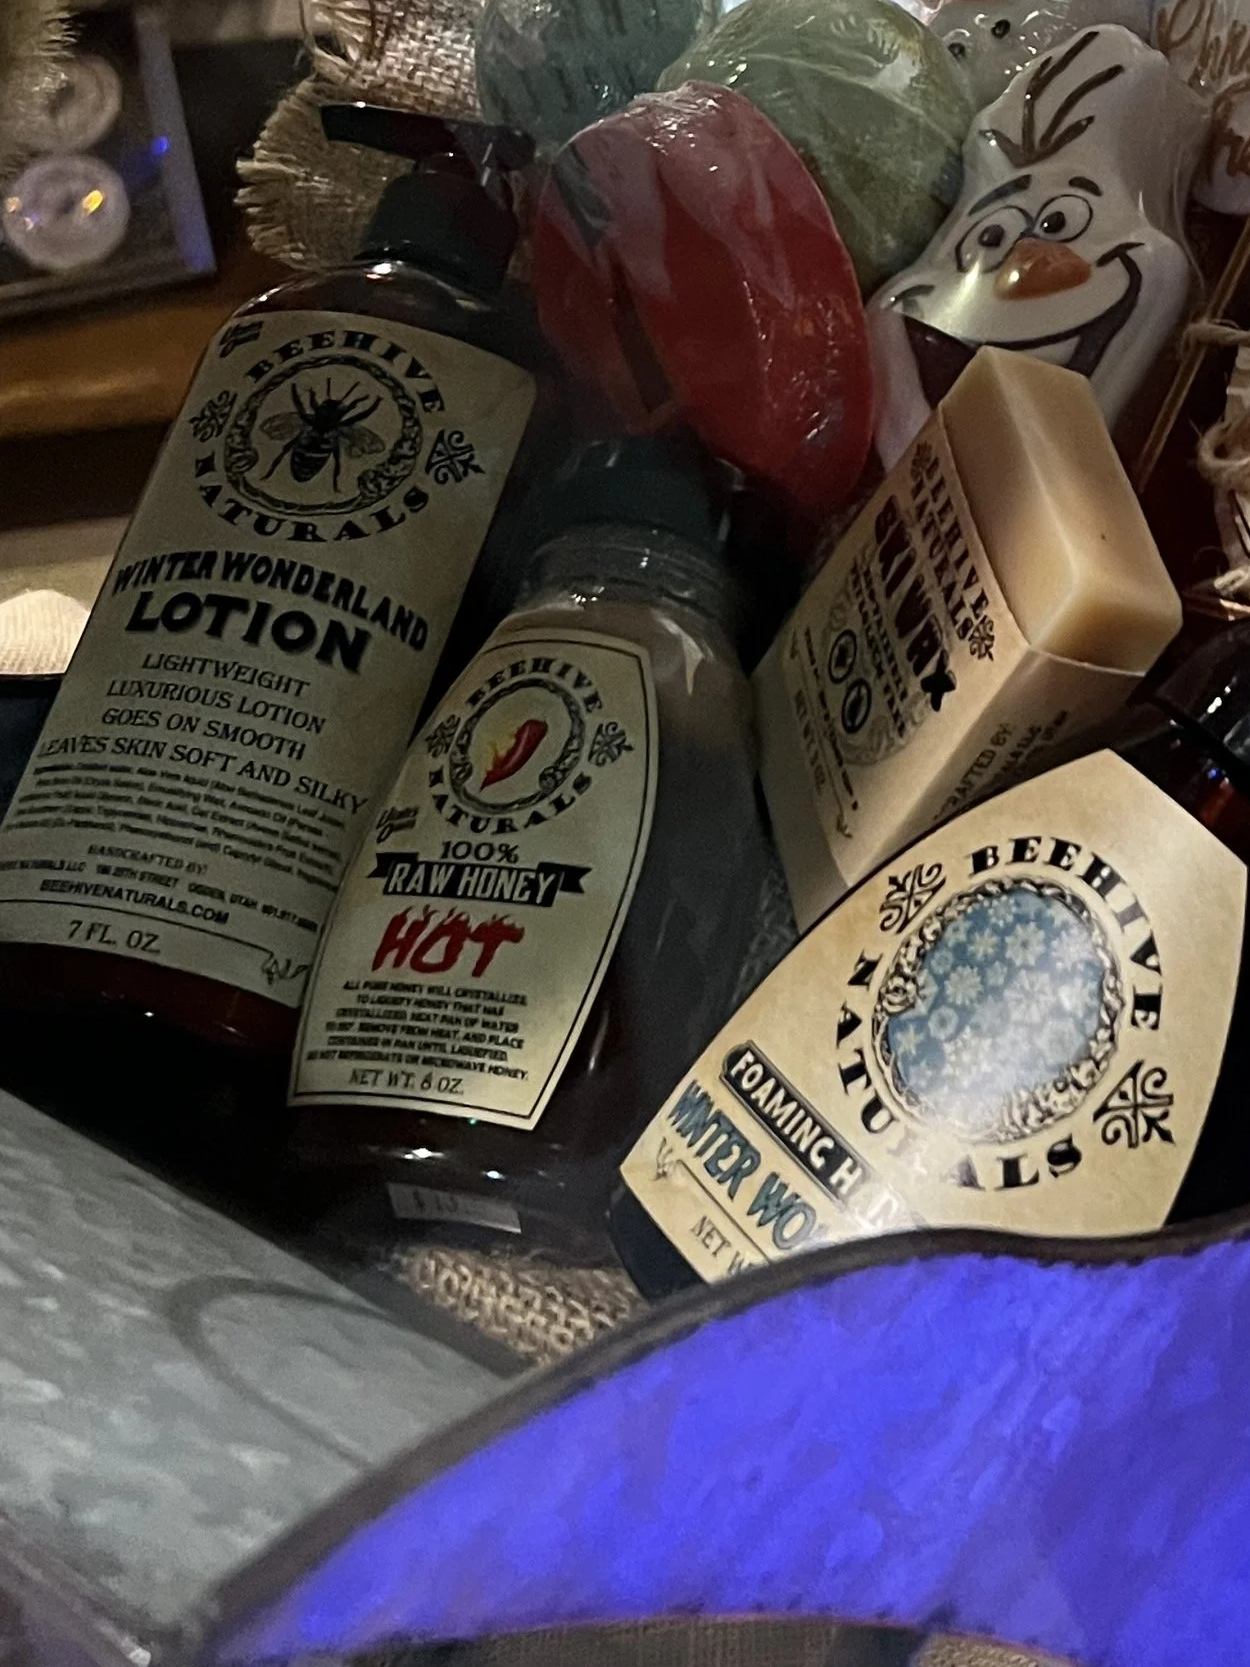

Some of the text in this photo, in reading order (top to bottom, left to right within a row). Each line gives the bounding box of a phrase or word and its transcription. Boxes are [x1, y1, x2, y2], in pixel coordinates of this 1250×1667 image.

[244, 329, 446, 414] BEEHIVE
[194, 453, 430, 543] NATURALS
[112, 550, 429, 652] WINTER WONDERLAND
[125, 590, 373, 675] LOTION
[106, 680, 327, 734] LUXURIOUS LOTION
[141, 653, 311, 698] LIGHTWEIGHT
[465, 657, 602, 714] BEEHIVE
[102, 707, 307, 761] GOES ON SMOOTH
[37, 735, 370, 816] LEAVES SKIN SOFT AND SILKY
[428, 765, 593, 835] NATURALS
[87, 844, 184, 870] HANDCRAFTED
[387, 862, 556, 905] RAW HONEY
[440, 840, 519, 864] 100%
[40, 879, 230, 925] BEEHIVENATURALS.COM
[67, 919, 83, 940] 7
[965, 834, 1163, 1032] BEEHIVE
[372, 904, 525, 978] HOT
[350, 1068, 383, 1086] NET
[835, 949, 1085, 1191] NATUALS
[667, 1078, 763, 1201] WINTER
[730, 1050, 835, 1172] FOAMING
[690, 1214, 732, 1259] NET
